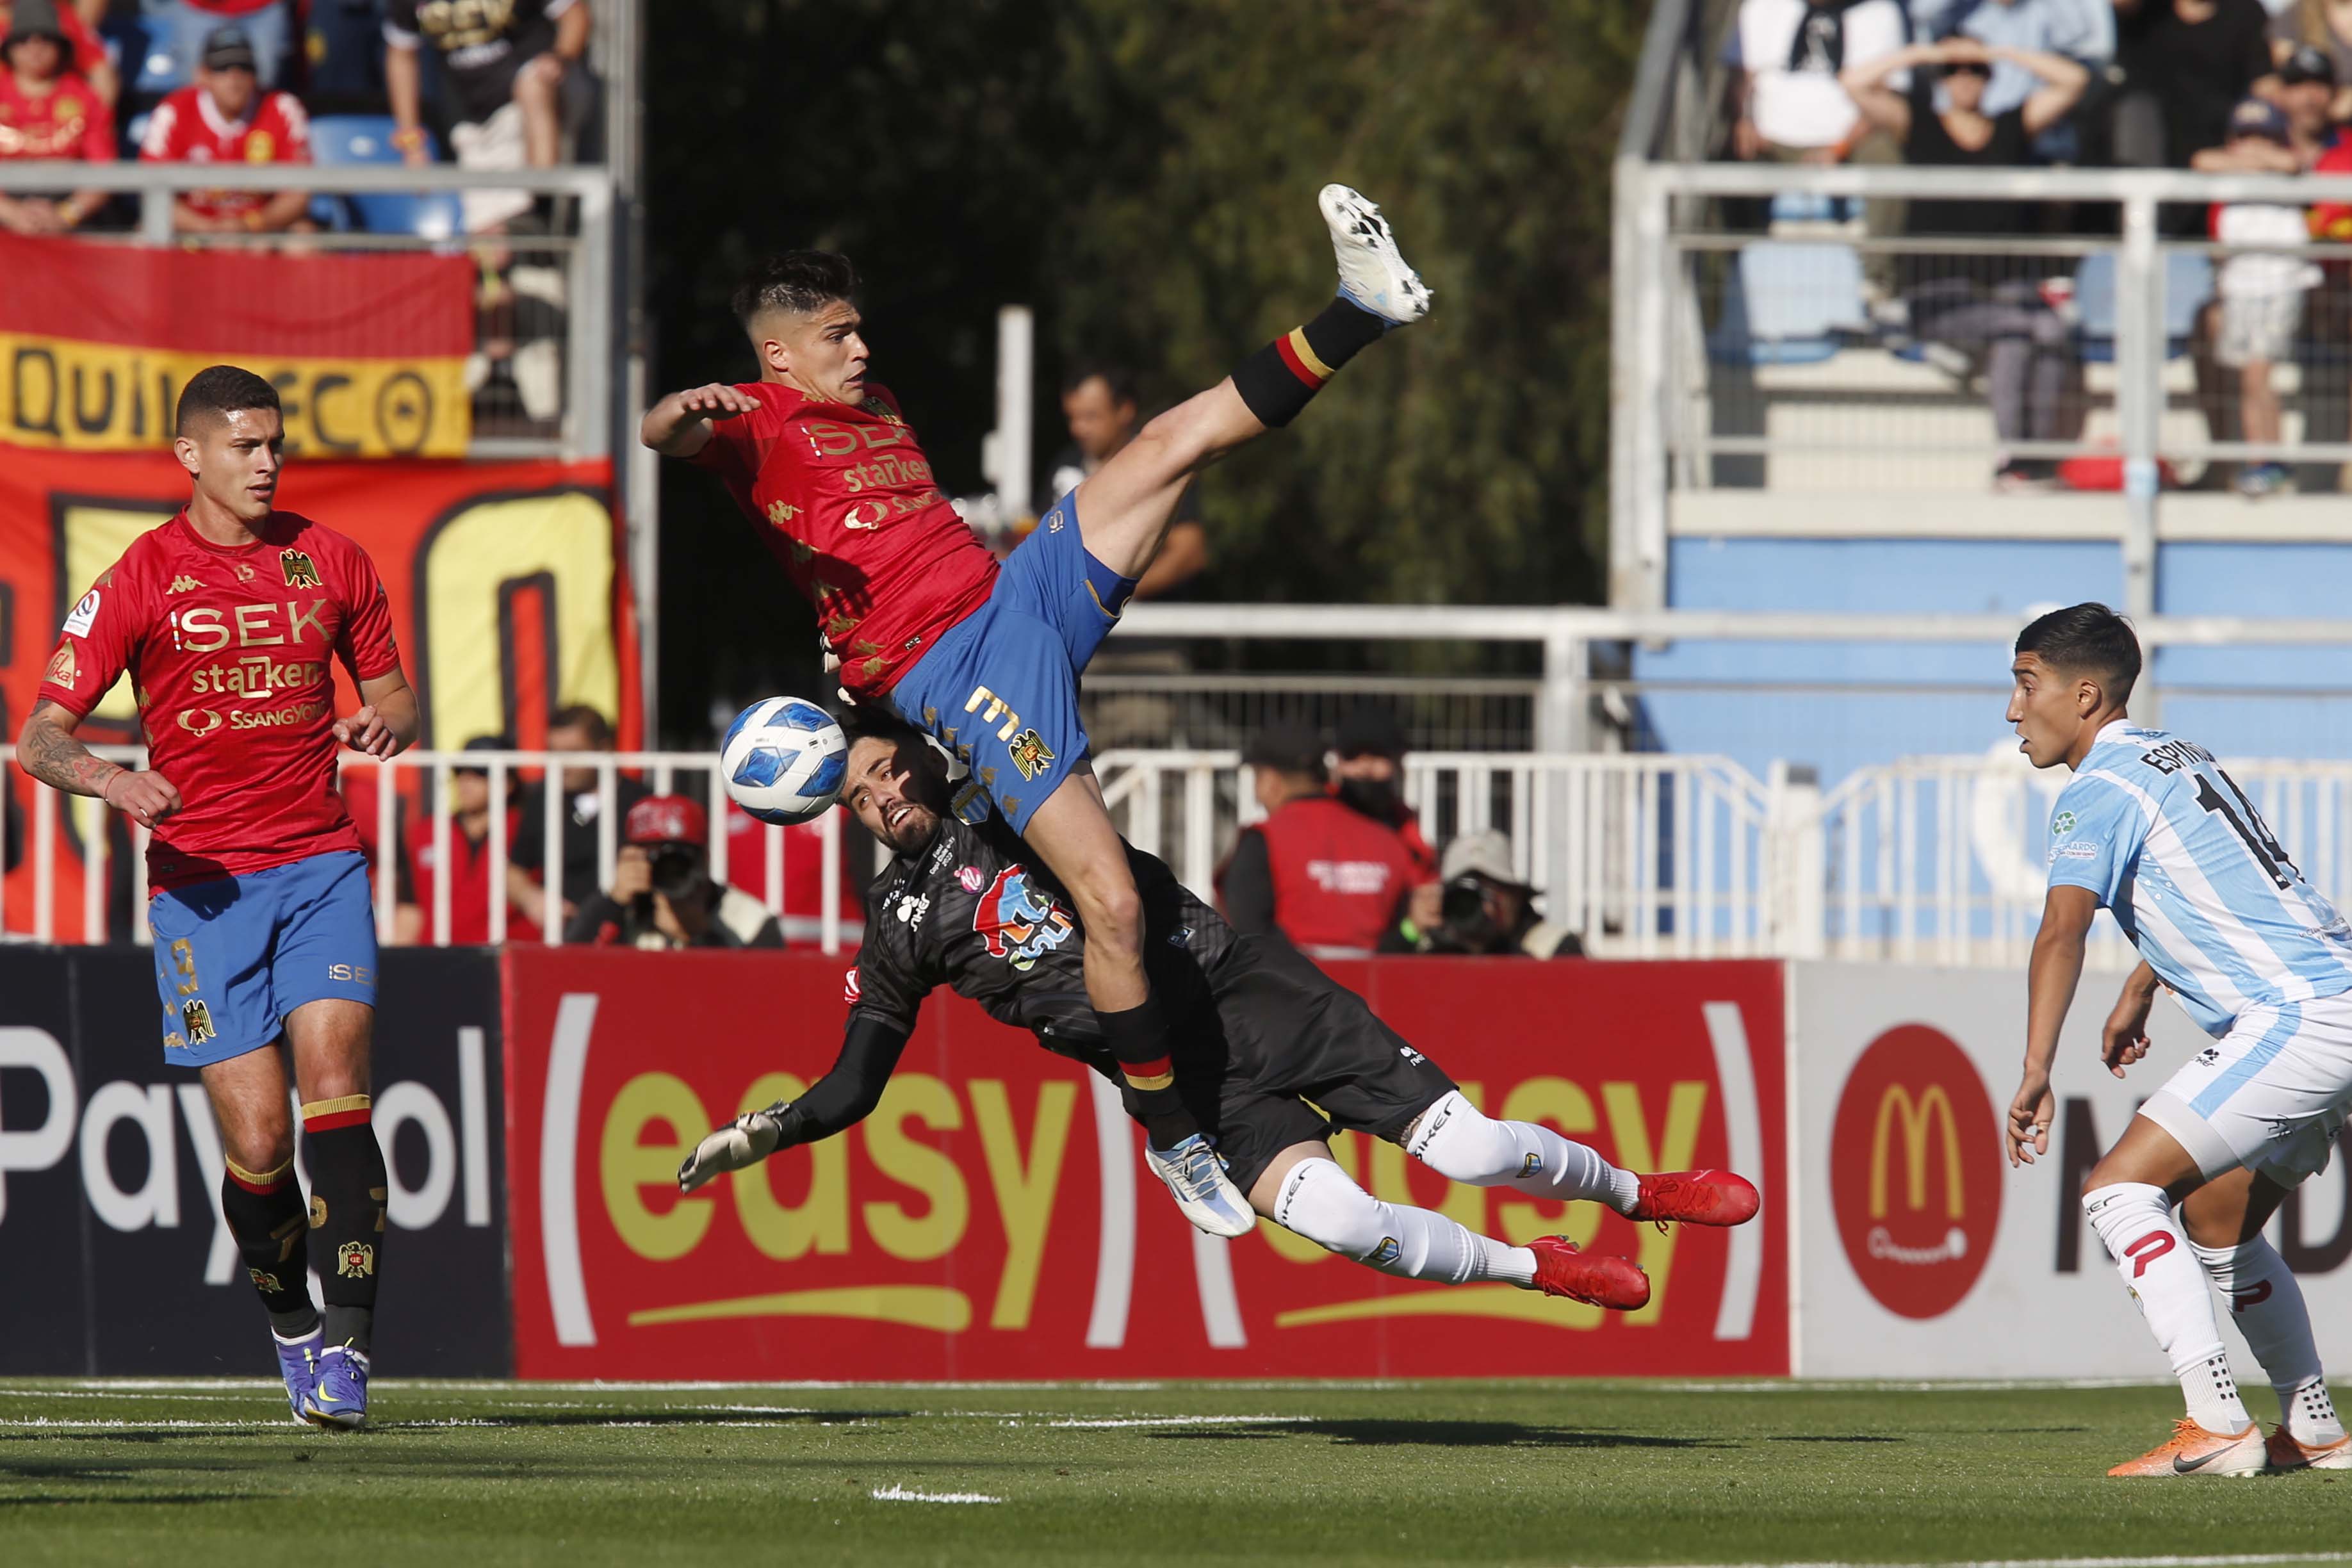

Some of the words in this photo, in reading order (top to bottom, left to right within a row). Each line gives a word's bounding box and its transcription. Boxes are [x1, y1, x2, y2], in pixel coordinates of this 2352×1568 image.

[192, 660, 319, 696] starken
[2194, 770, 2306, 891] 14
[332, 963, 373, 984] SE
[0, 1025, 492, 1313] Payol
